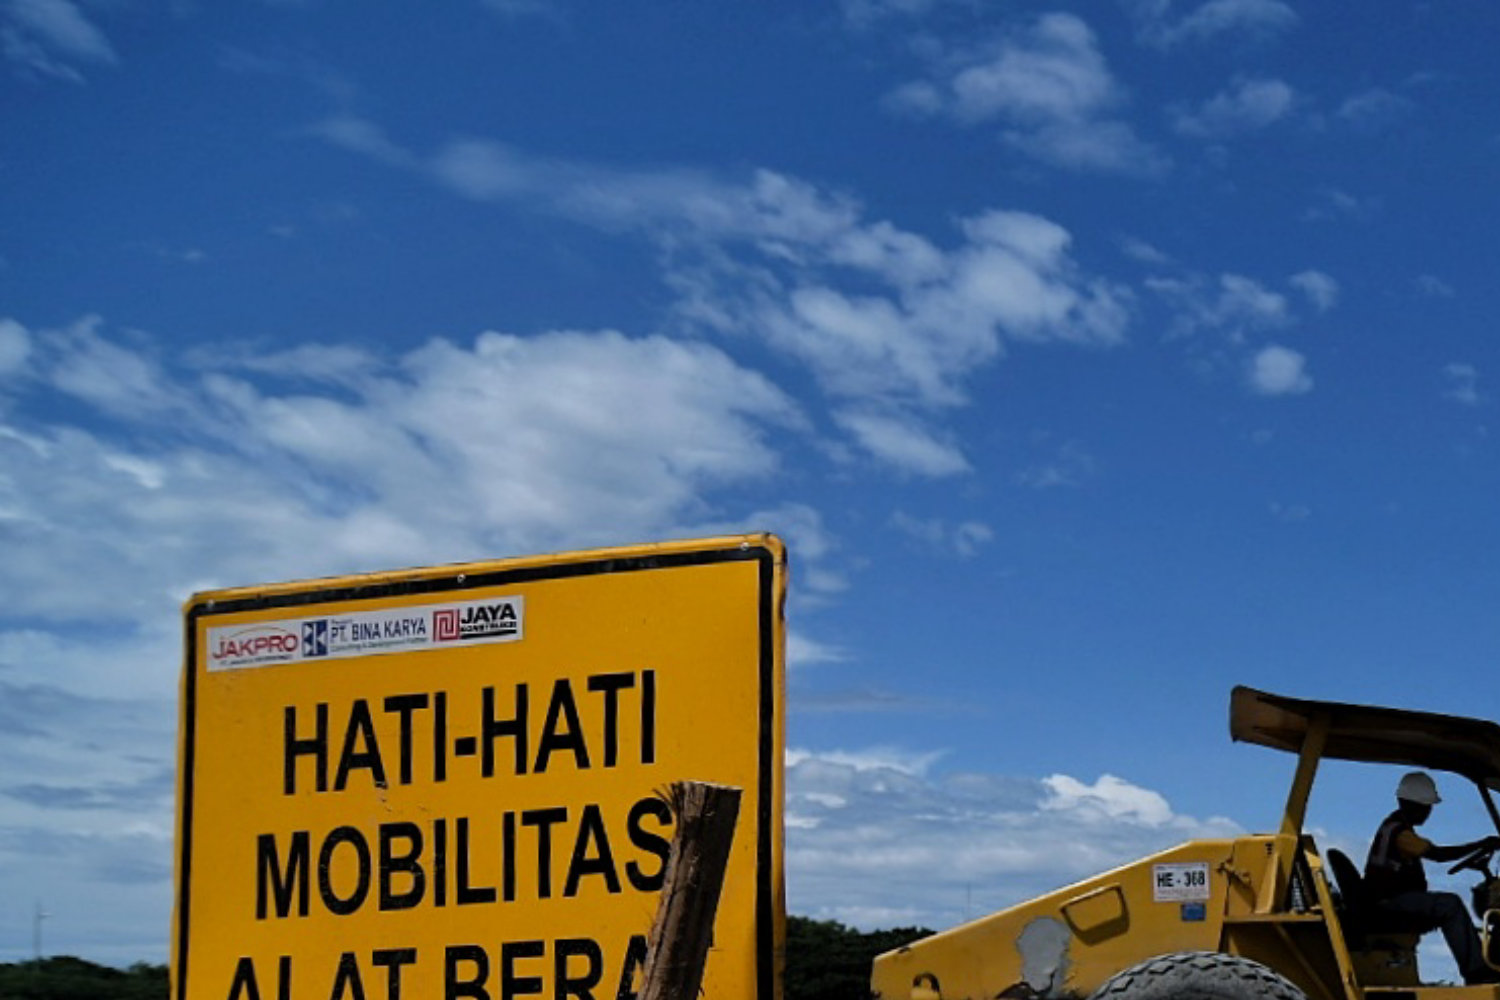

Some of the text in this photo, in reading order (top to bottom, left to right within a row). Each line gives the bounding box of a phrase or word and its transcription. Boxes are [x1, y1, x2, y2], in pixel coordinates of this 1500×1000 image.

[461, 603, 517, 624] JAYA
[352, 623, 381, 641] BINA
[384, 618, 426, 638] KARYA
[213, 633, 298, 659] JAKPRO
[284, 669, 656, 795] HATI-HATI
[256, 797, 673, 920] MOBILITAS
